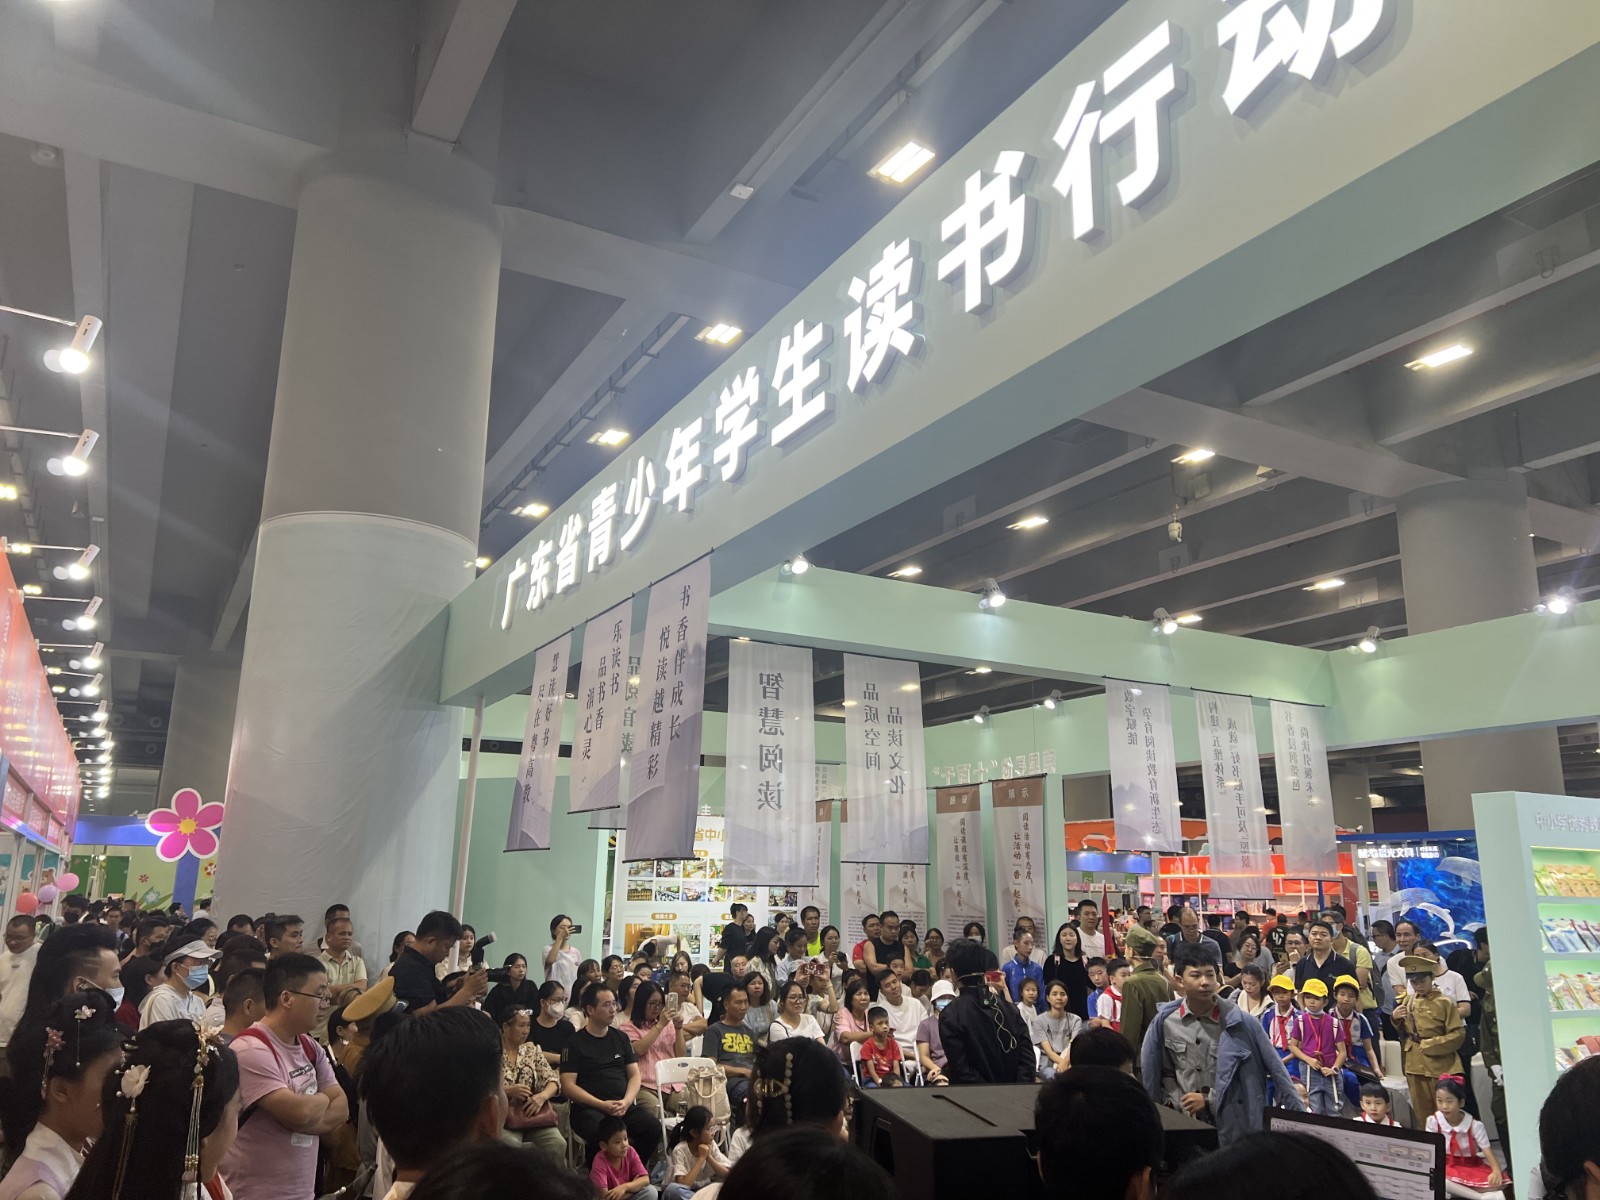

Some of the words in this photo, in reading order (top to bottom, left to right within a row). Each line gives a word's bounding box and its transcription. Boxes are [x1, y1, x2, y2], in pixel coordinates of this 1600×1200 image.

[501, 0, 1387, 630] 广东省青少年学生读书行动
[595, 656, 607, 731] 品书香
[610, 619, 623, 696] 乐读书
[647, 624, 671, 781] 悦读越精彩
[668, 584, 691, 741] 书香伴成长
[721, 1032, 753, 1045] STAR
